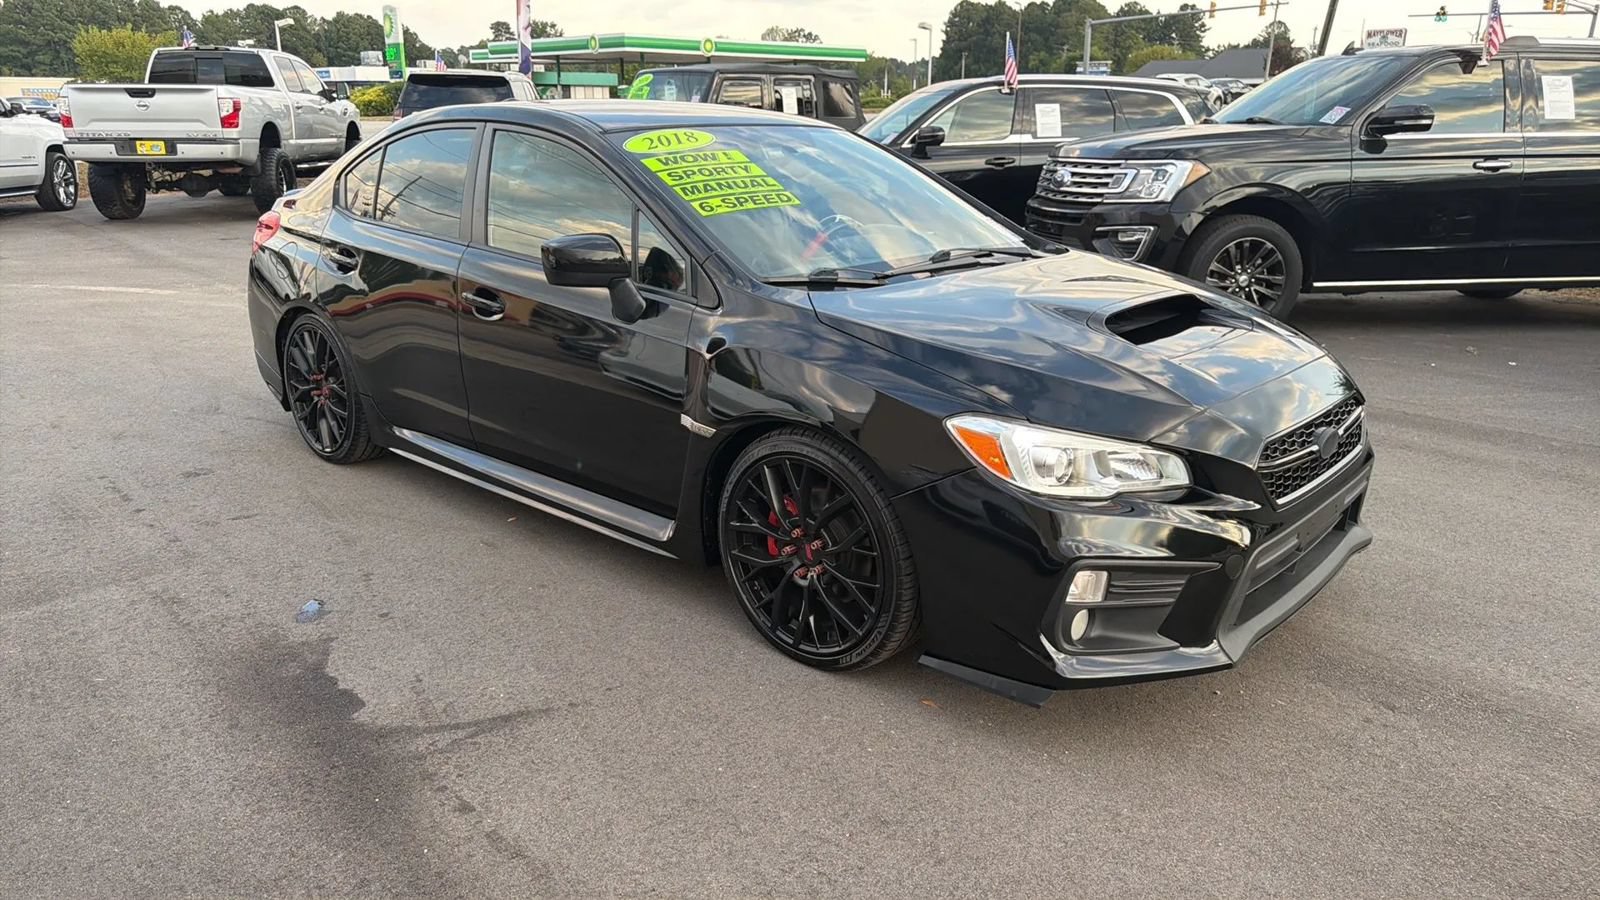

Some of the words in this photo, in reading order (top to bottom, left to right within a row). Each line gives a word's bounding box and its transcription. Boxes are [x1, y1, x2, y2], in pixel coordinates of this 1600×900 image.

[642, 131, 699, 150] 2018
[666, 164, 752, 182] SPORTY
[680, 177, 777, 197] MANUAL
[698, 193, 793, 212] 6-SPEED
